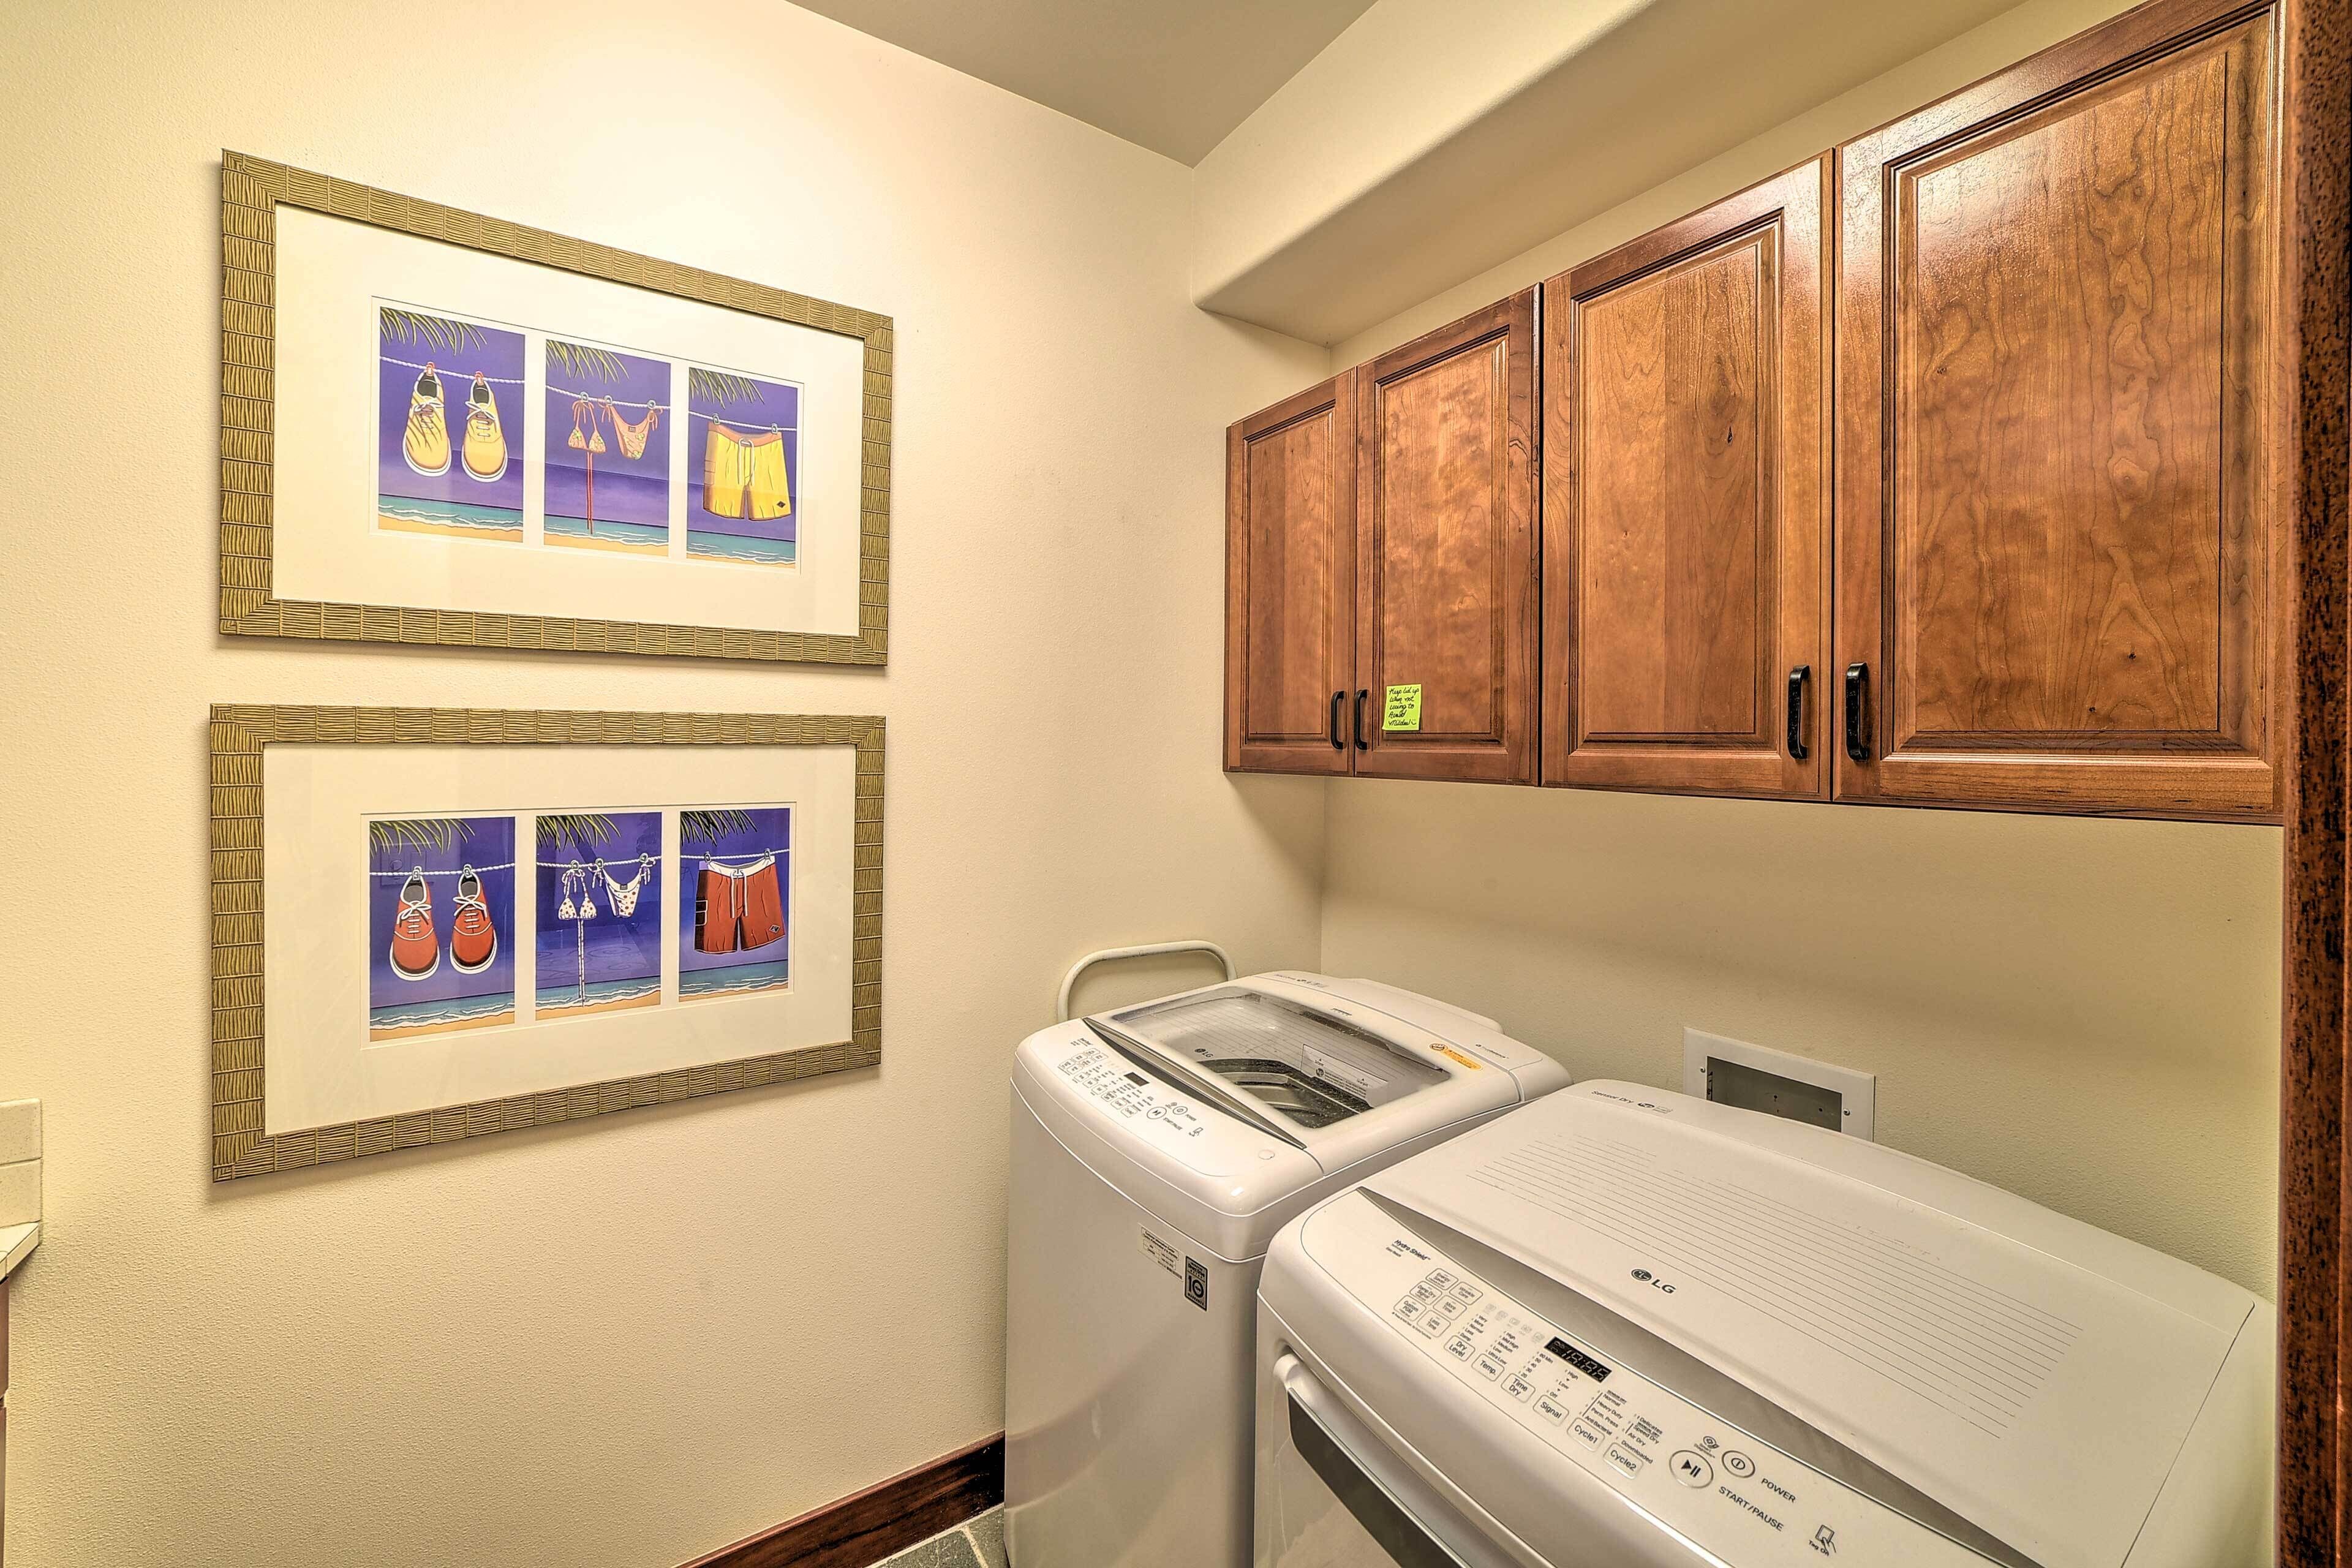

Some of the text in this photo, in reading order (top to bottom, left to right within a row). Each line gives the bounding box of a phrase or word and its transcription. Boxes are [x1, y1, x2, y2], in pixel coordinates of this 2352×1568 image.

[1394, 1240, 1411, 1250] Hydro
[1651, 1279, 1676, 1294] LG
[1469, 1324, 1483, 1333] Normal
[1460, 1333, 1471, 1341] Damp
[1449, 1344, 1465, 1357] Level
[1456, 1341, 1467, 1351] Dry
[1498, 1341, 1513, 1352] Medium
[1488, 1351, 1498, 1359] Ultra
[1480, 1360, 1496, 1375] Temp.
[1567, 1371, 1578, 1380] High
[1509, 1385, 1521, 1396] Dry
[1513, 1378, 1528, 1392] Time
[1602, 1394, 1621, 1407] Normal
[1540, 1401, 1562, 1419] Signal
[1596, 1400, 1623, 1419] Heavy Duty
[1591, 1407, 1619, 1428] Perm. Press
[1639, 1416, 1662, 1434] Delicates
[1574, 1425, 1599, 1444] Cycle1
[1591, 1421, 1612, 1436] Bacterial
[1632, 1424, 1660, 1444] Speed Dry
[1635, 1437, 1646, 1446] Dry
[1621, 1440, 1653, 1464] Downloaded
[1610, 1450, 1637, 1471] Cycle2
[1761, 1478, 1796, 1503] POWER
[1719, 1486, 1784, 1532] START/PAUSE
[1809, 1540, 1830, 1556] Tag On
